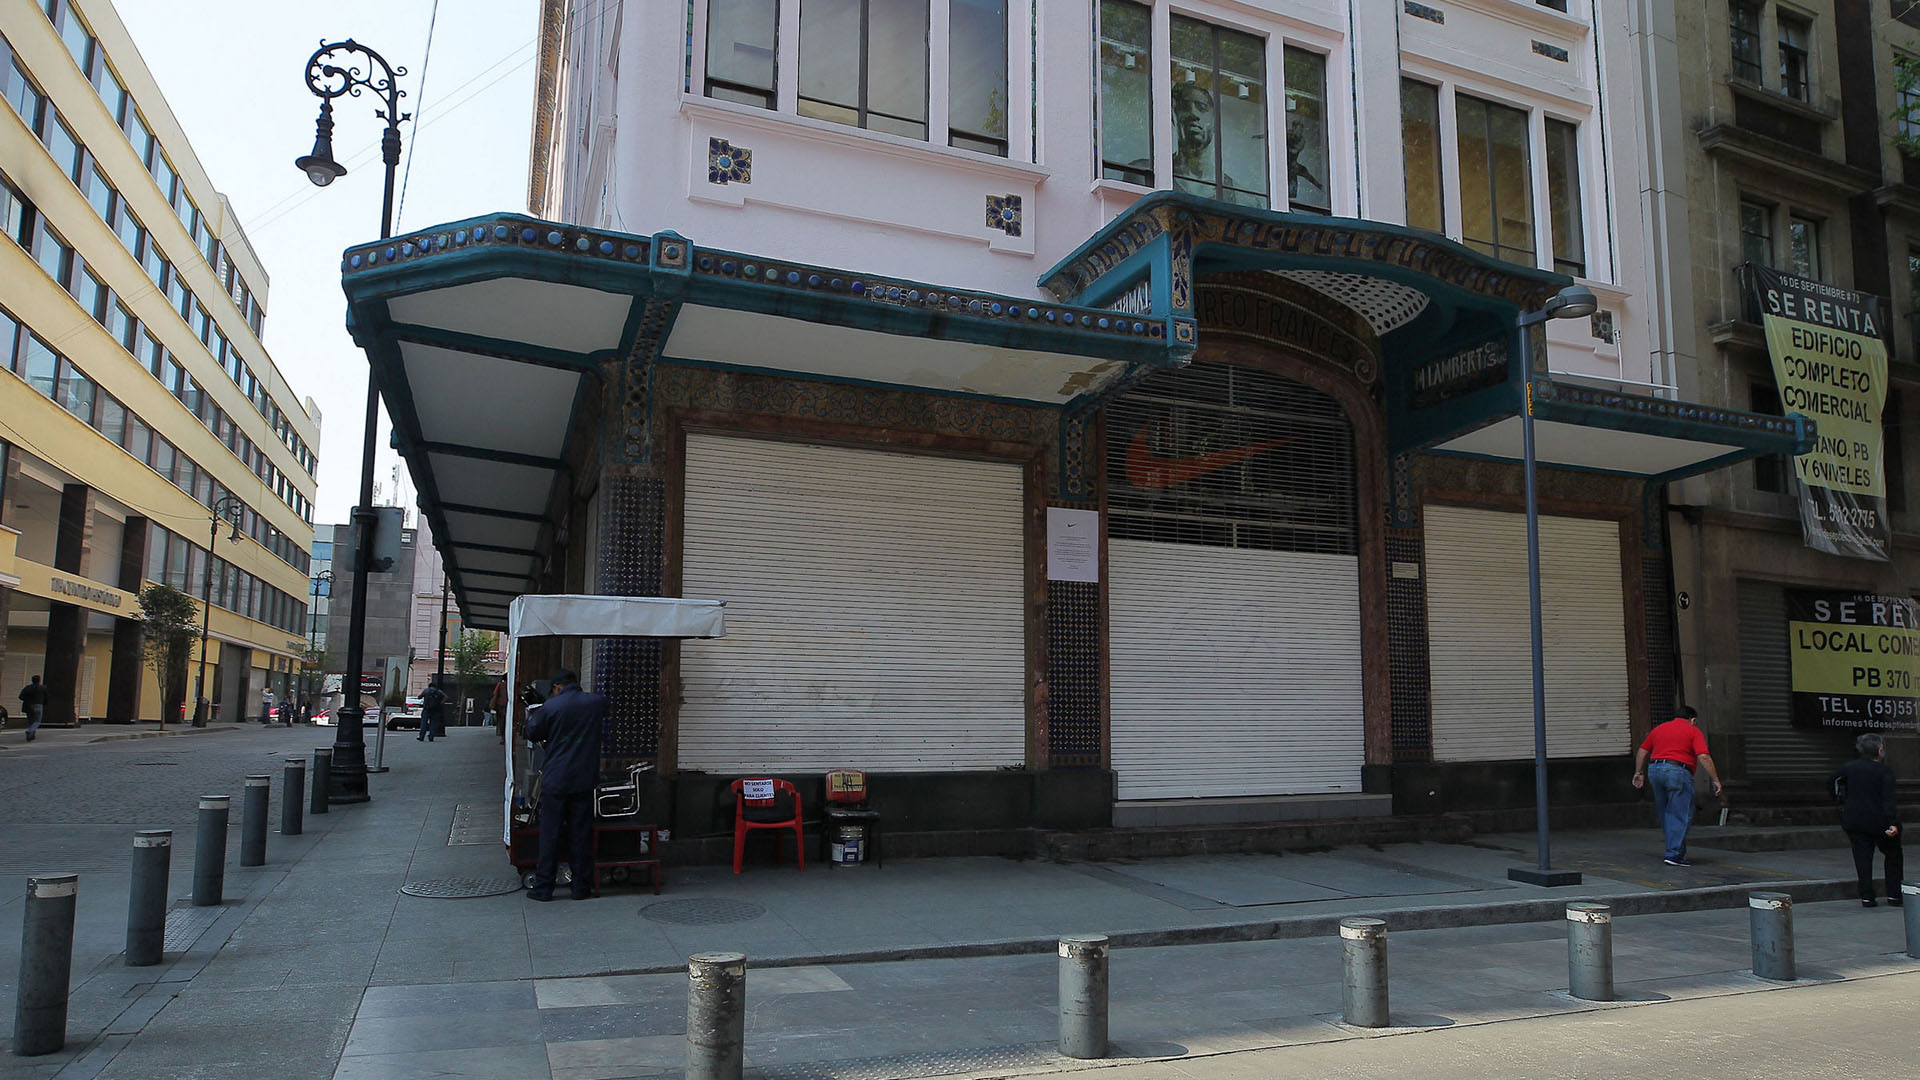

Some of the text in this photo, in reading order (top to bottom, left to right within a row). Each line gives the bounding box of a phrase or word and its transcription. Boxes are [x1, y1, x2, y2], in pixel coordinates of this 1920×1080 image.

[1779, 275, 1788, 286] 16
[1789, 278, 1799, 289] DE
[1800, 280, 1845, 301] SEPTIEMBRE
[1767, 289, 1877, 335] SE RENTA
[1792, 327, 1862, 361] EDIFICIO
[1784, 356, 1870, 393] COMPLETO
[1784, 386, 1872, 424] COMERCIAL
[1853, 442, 1869, 461] PB
[1800, 458, 1808, 476] Y
[1814, 599, 1857, 623] SE
[1799, 629, 1873, 653] LOCAL
[1853, 667, 1881, 688] PB
[1887, 670, 1910, 689] 370
[1818, 696, 1861, 714] TEL.
